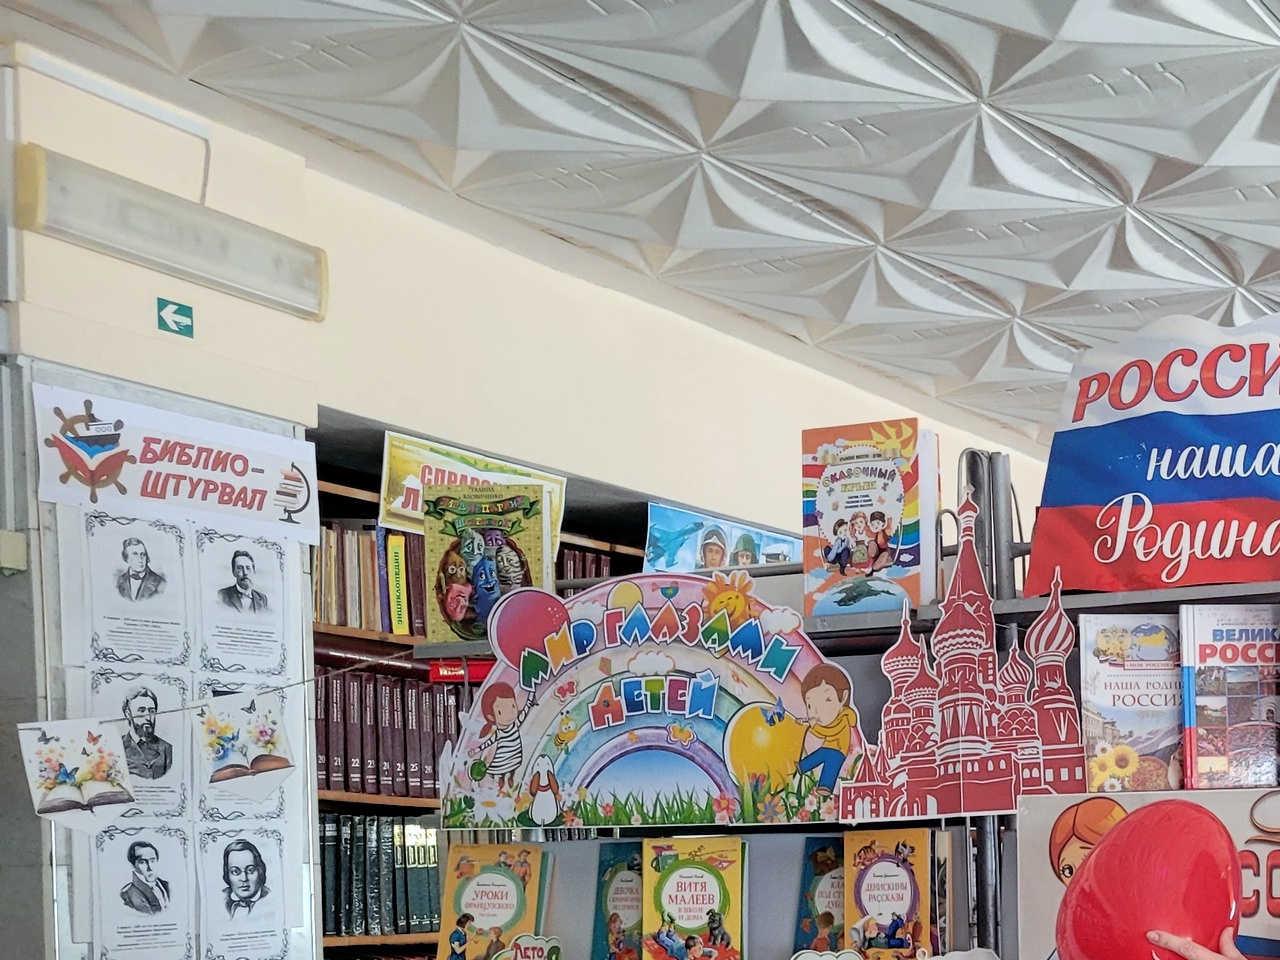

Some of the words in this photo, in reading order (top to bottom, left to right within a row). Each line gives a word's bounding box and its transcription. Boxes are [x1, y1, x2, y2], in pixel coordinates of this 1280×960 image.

[139, 436, 265, 478] БИБЛИО-
[822, 466, 897, 487] СКАЗОЧНЫЙ
[140, 470, 267, 512] ШТУРВАЛ
[520, 619, 597, 691] МИР
[604, 600, 803, 684] ГЛАЗАМИ
[1104, 682, 1140, 690] НАША
[588, 669, 719, 731] ДЕТЕЙ
[351, 758, 360, 767] 22
[410, 763, 418, 772] 25
[676, 882, 707, 892] ВИТЯ
[472, 890, 508, 901] УРОКИ
[668, 894, 714, 905] МАЛЕЕВ
[868, 894, 904, 903] РАССКАЗЫ
